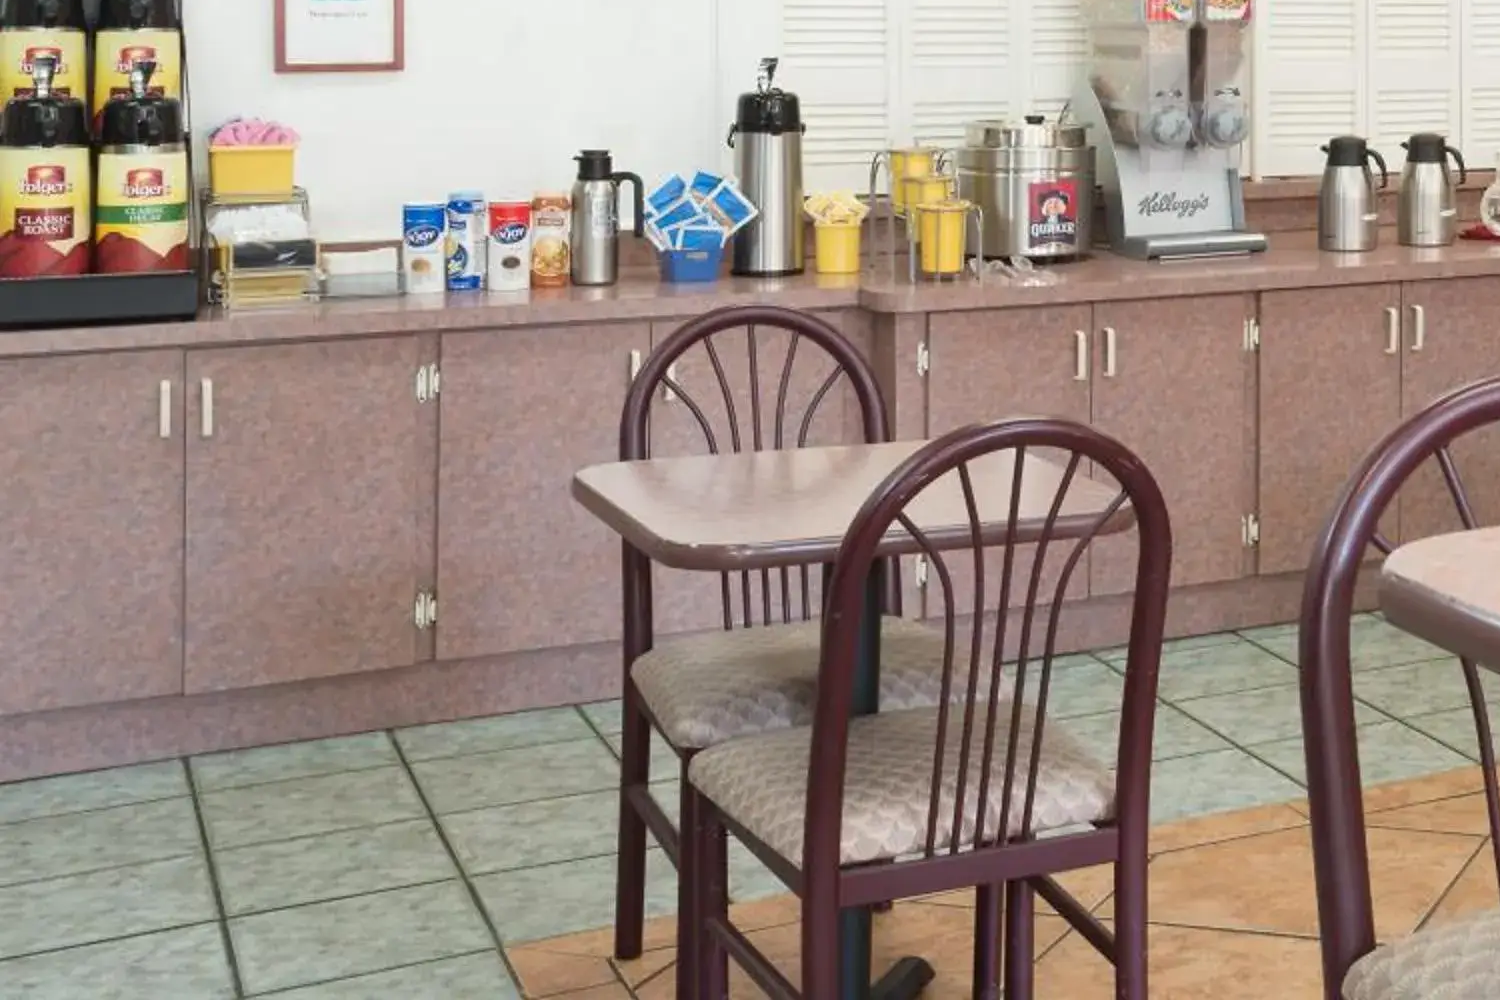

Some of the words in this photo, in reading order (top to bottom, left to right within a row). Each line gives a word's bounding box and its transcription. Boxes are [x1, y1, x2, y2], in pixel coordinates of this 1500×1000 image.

[1137, 191, 1210, 219] Kellogg's
[18, 214, 72, 226] CLASSIC
[1031, 222, 1075, 237] QUAKER
